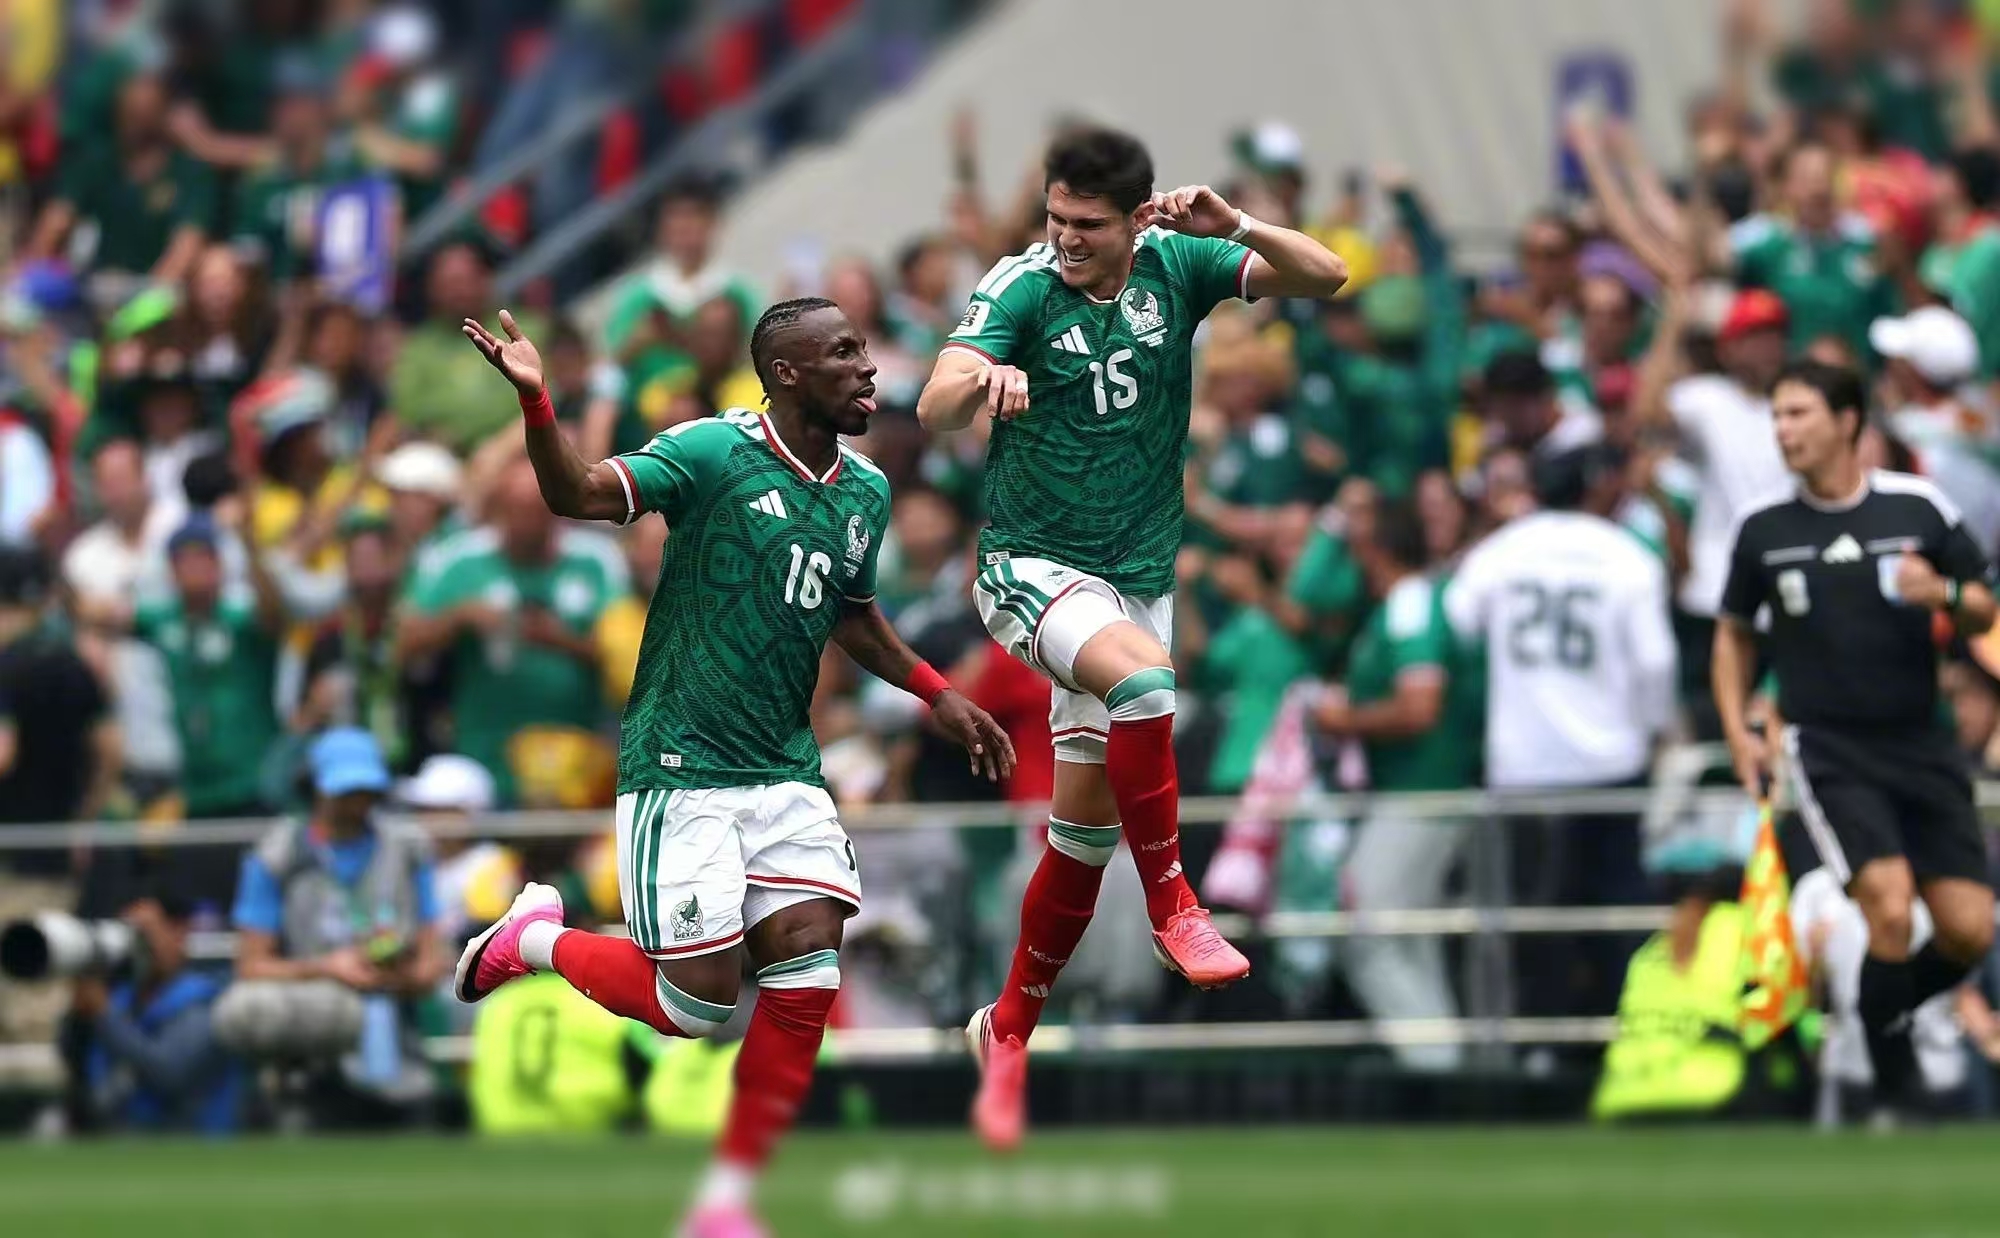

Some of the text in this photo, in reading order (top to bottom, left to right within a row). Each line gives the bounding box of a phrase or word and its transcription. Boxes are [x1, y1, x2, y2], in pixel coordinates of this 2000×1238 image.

[1089, 349, 1138, 415] 15
[785, 543, 832, 609] 16
[1504, 580, 1600, 674] 26
